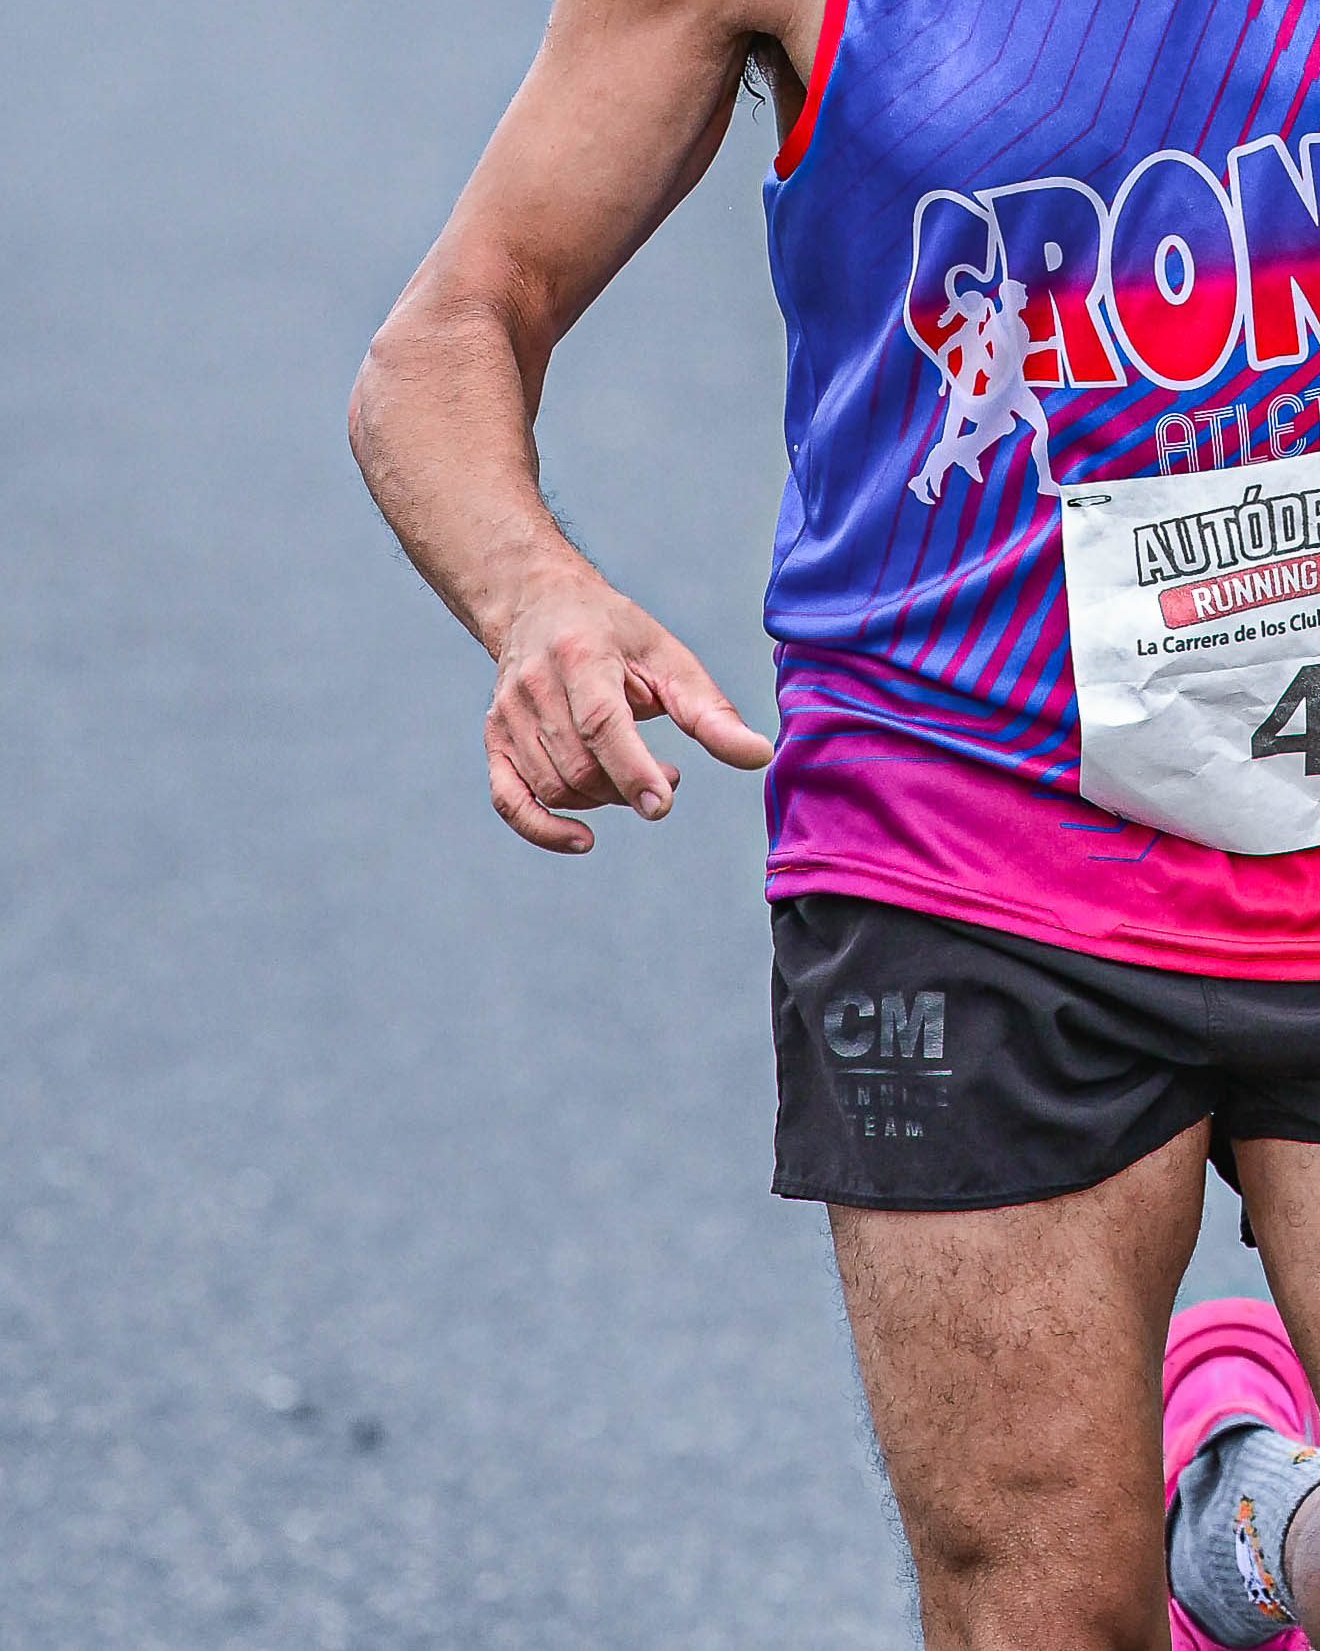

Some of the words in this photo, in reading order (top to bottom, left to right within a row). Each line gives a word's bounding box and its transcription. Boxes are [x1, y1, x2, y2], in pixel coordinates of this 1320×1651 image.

[1192, 559, 1317, 618] RUNNING
[1137, 638, 1158, 656] La
[1162, 629, 1229, 654] Carrera
[1234, 623, 1257, 642] de
[1261, 618, 1286, 638] los
[823, 990, 946, 1059] CM
